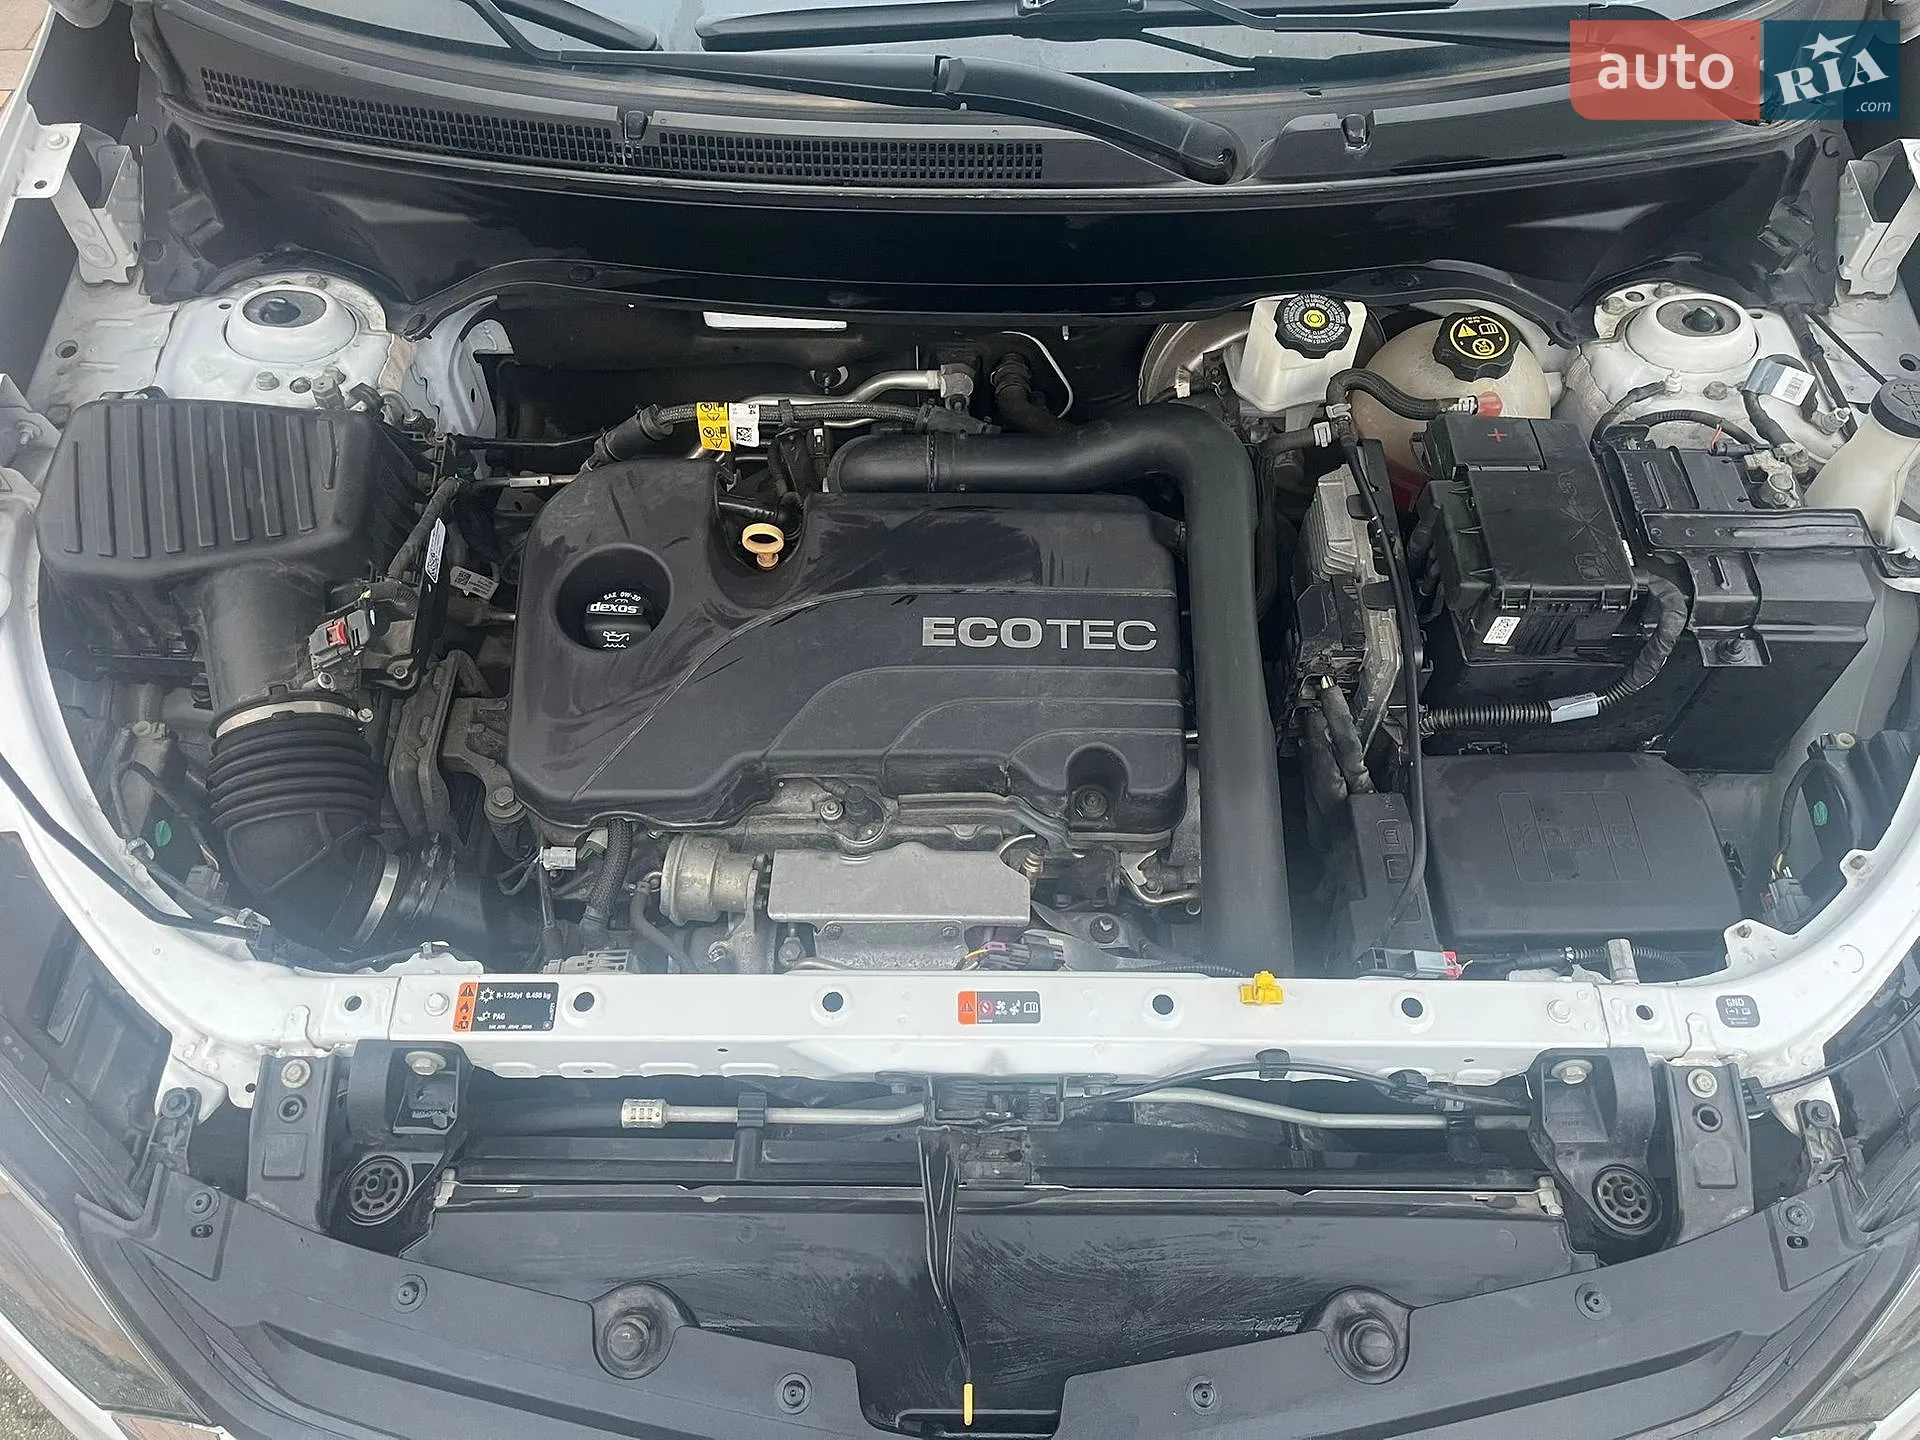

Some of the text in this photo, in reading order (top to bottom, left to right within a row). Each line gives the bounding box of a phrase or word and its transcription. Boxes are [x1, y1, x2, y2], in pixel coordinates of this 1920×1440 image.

[603, 591, 617, 601] SAE
[589, 601, 640, 614] dexos
[922, 616, 1157, 651] ECOTEC
[543, 991, 552, 1001] kg
[1725, 998, 1745, 1007] GND
[492, 1012, 506, 1021] PAG
